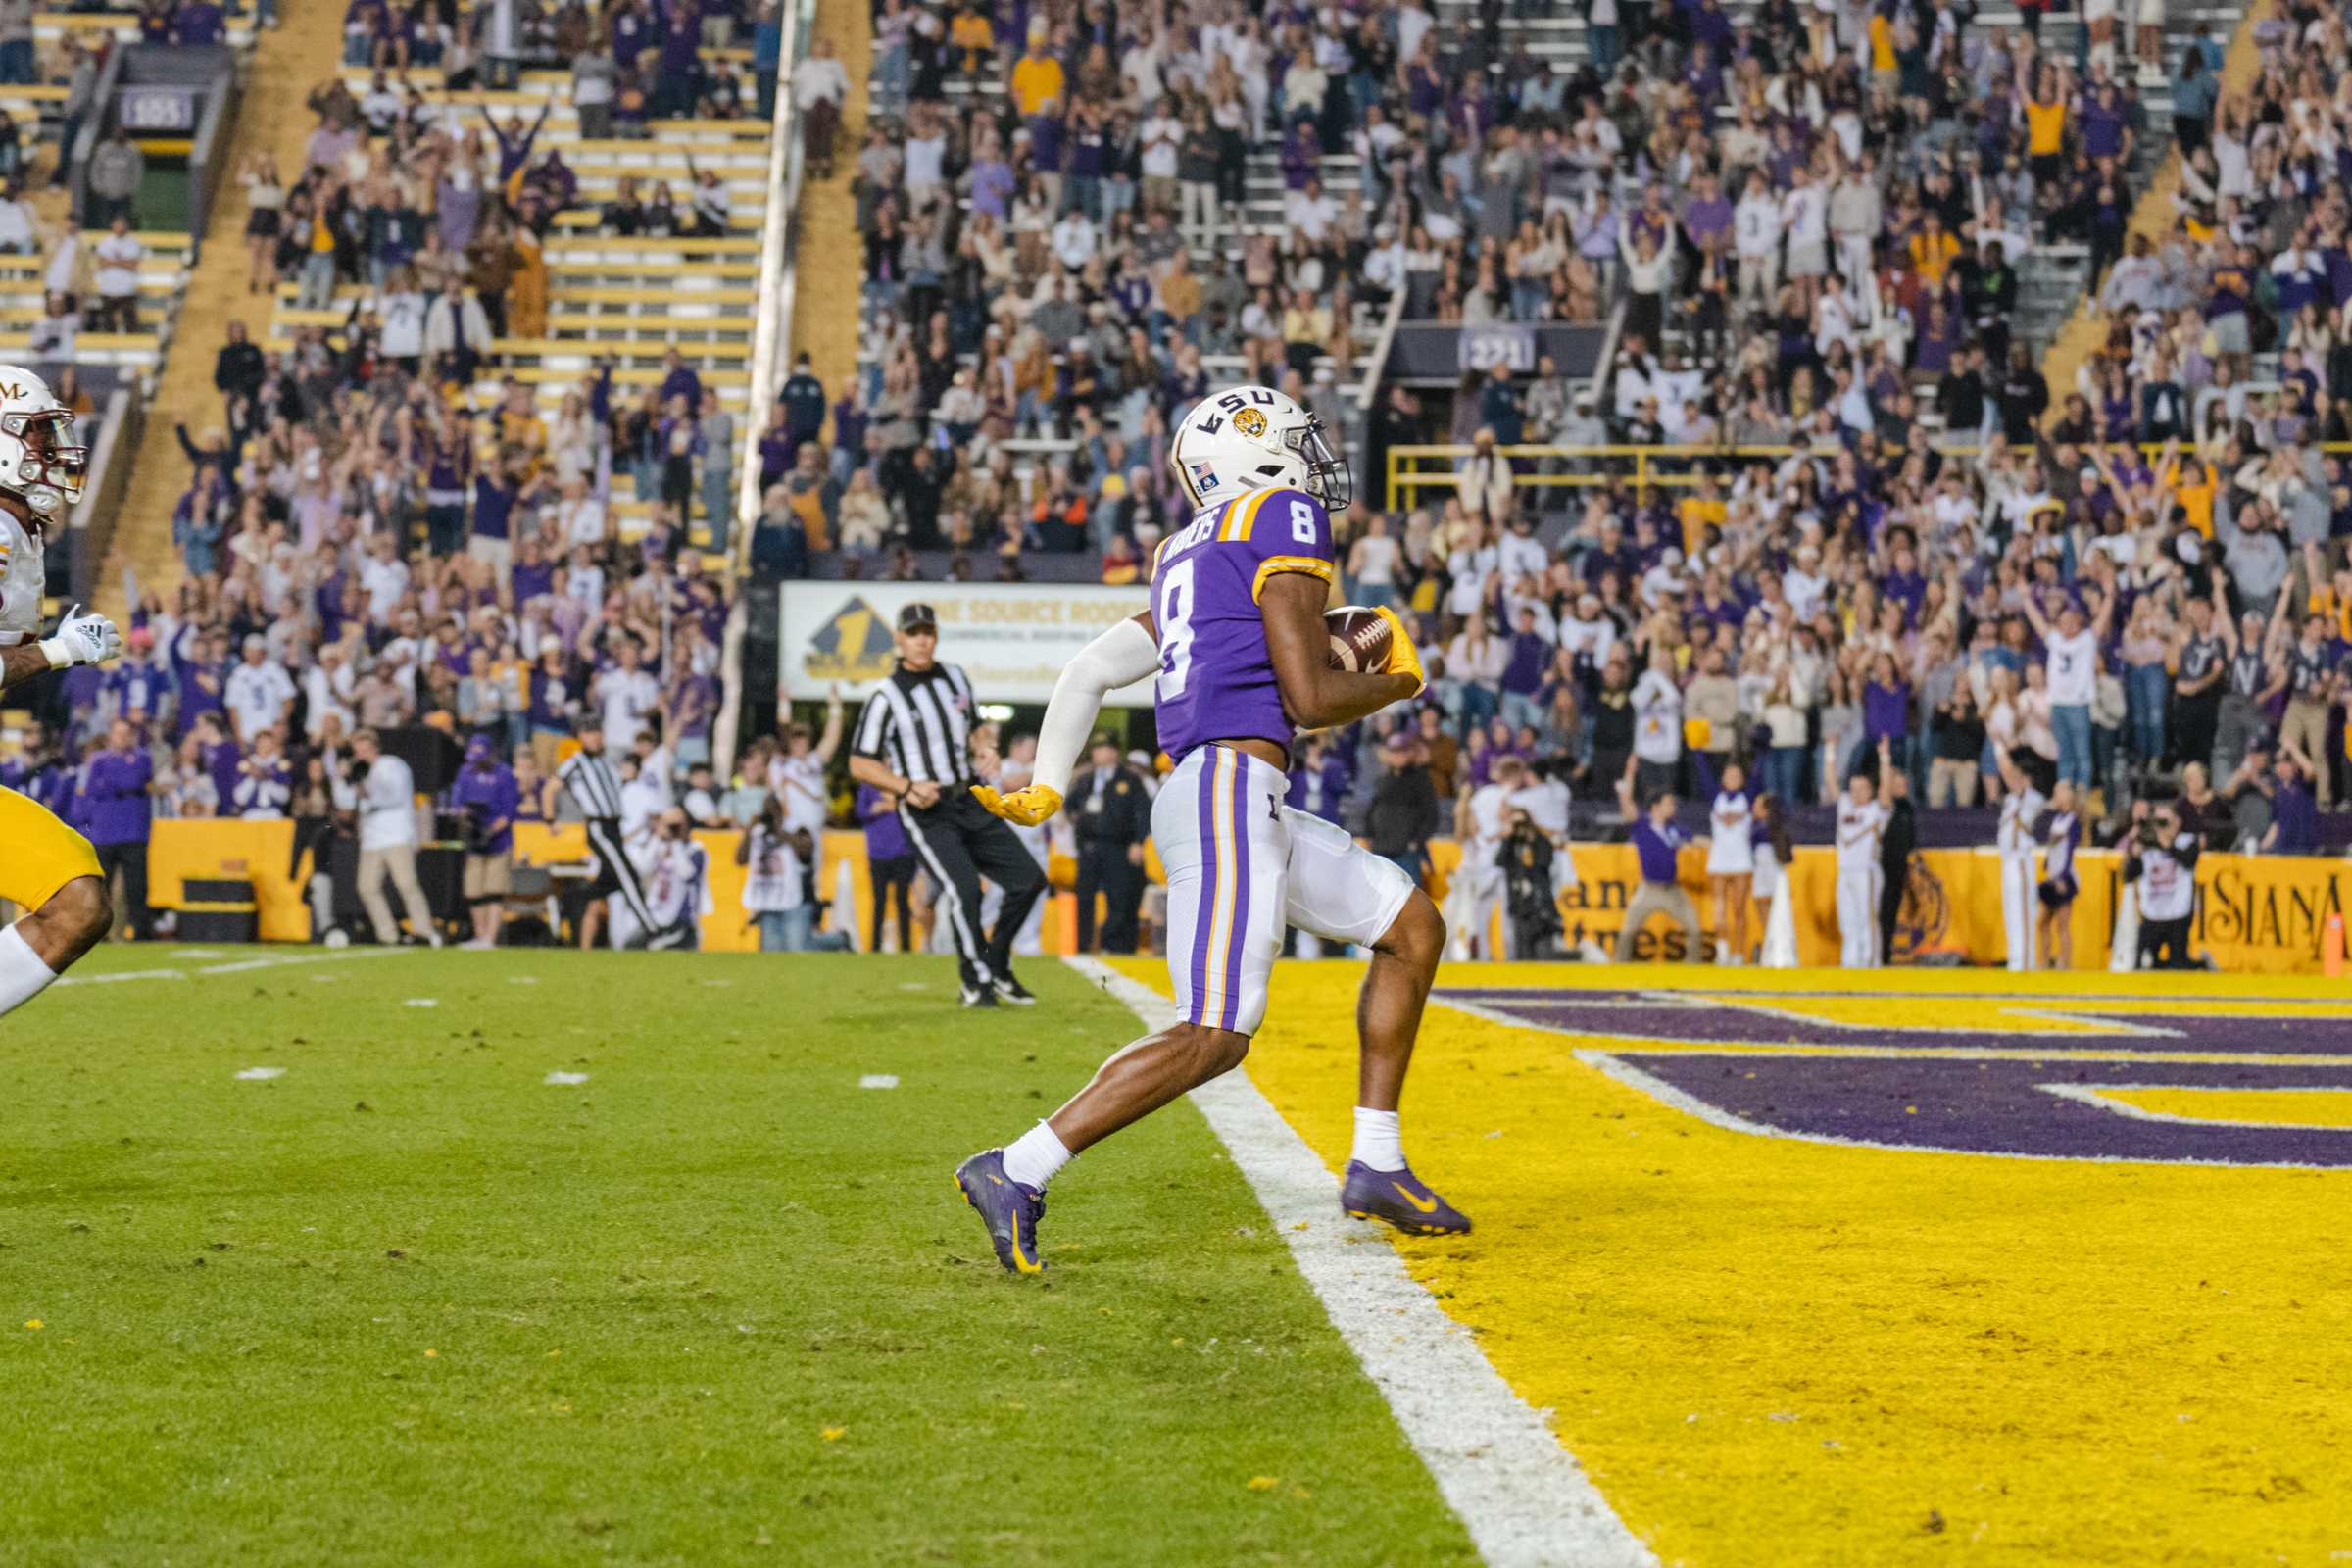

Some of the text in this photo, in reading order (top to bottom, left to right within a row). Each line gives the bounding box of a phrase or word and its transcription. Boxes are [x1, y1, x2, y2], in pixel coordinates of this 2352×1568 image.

[1197, 390, 1275, 435] LSU
[1289, 500, 1316, 545] 8
[969, 600, 1063, 622] SOURCE
[1156, 558, 1196, 703] 8
[836, 610, 871, 666] 1
[1563, 880, 1631, 909] an
[1572, 921, 1718, 962] tness
